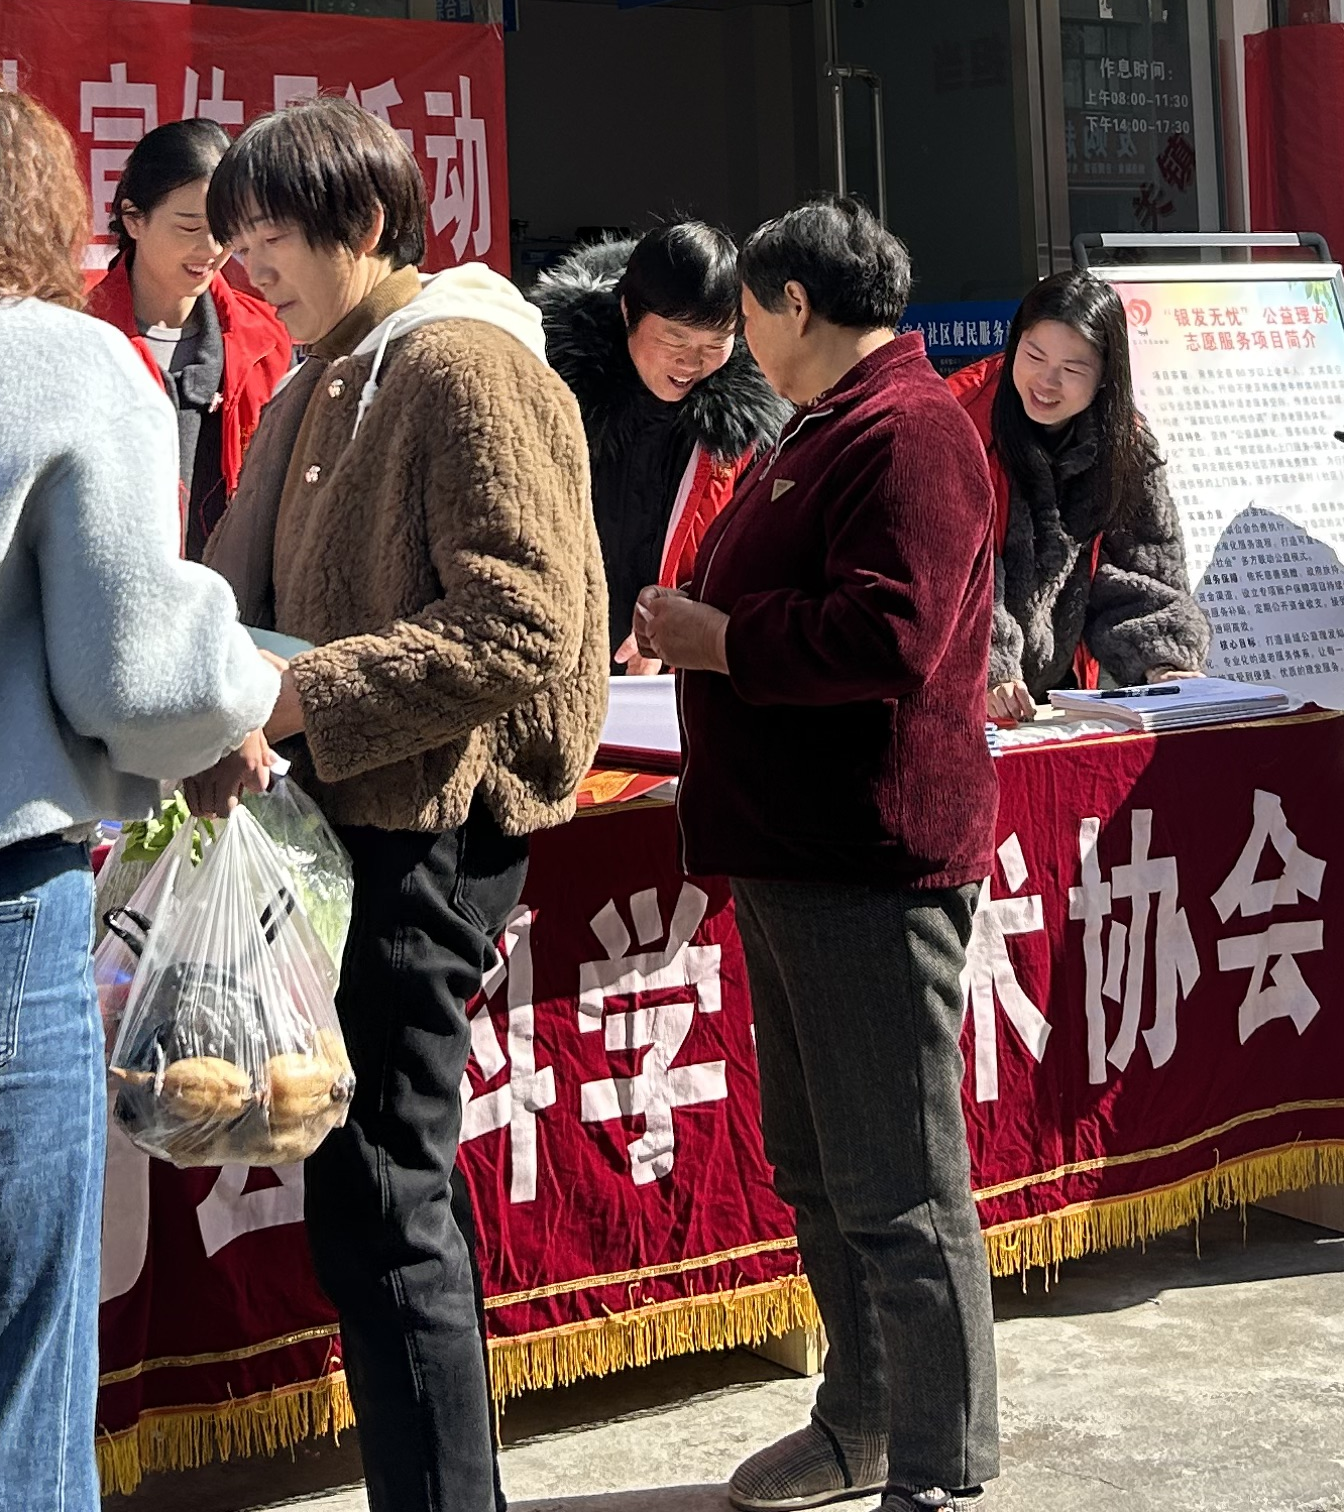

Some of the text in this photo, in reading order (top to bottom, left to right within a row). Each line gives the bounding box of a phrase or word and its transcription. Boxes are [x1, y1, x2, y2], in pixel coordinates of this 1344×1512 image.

[1184, 328, 1317, 352] 志愿服务项目简介
